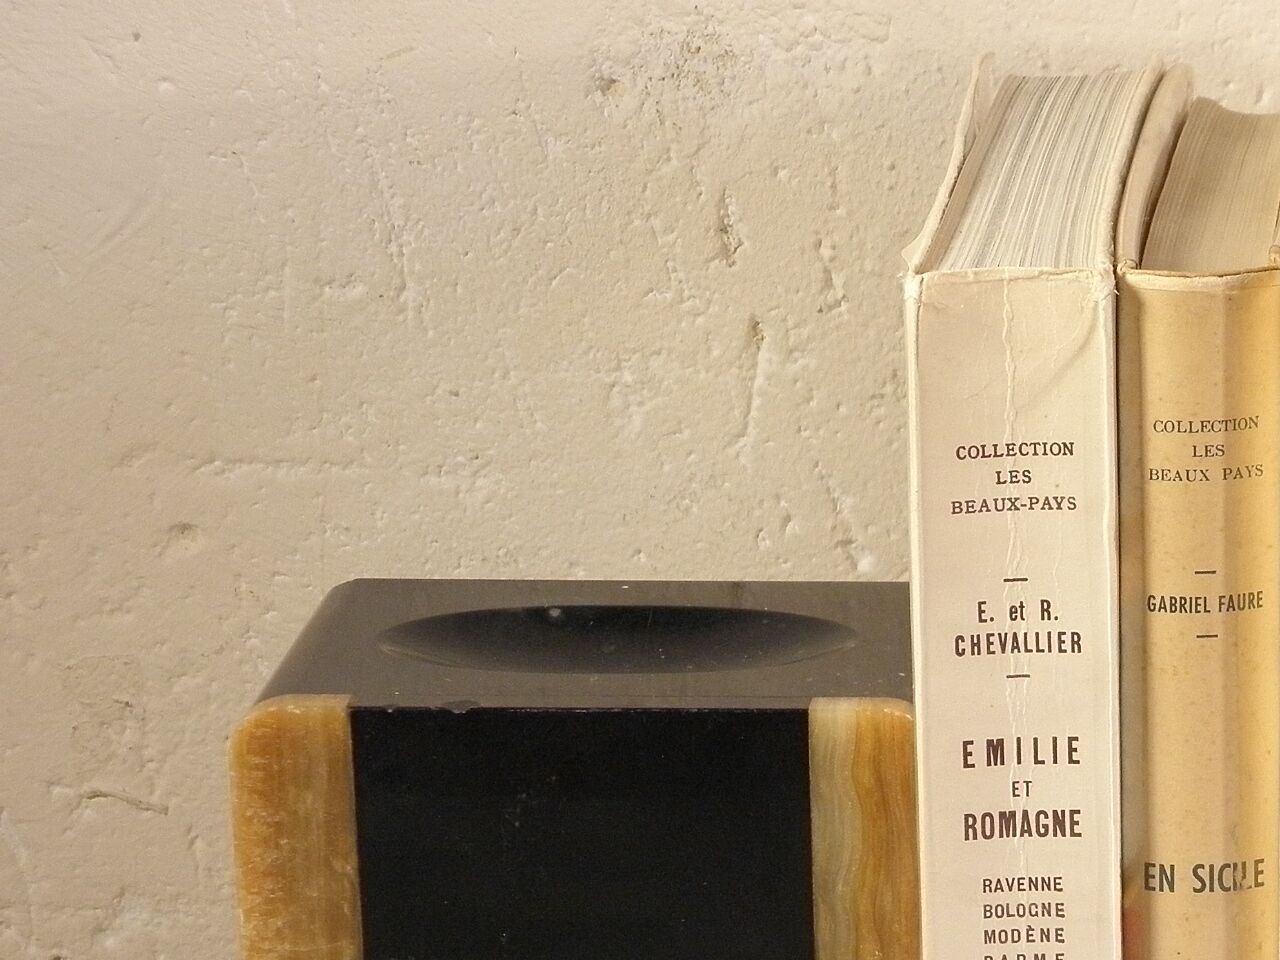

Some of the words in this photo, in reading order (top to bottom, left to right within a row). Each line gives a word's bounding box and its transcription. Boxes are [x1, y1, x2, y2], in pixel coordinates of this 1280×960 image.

[1153, 415, 1259, 435] COLLECTION
[956, 442, 1074, 461] COLLECTION
[1192, 442, 1225, 458] LES
[995, 469, 1032, 485] LES
[1149, 468, 1210, 482] BEAUX
[1222, 464, 1264, 481] PAYS
[951, 496, 1077, 515] BEAUX-PAYS
[978, 601, 994, 623] E.
[1009, 601, 1025, 621] et
[1040, 599, 1058, 621] R.
[1147, 595, 1211, 614] GABRIEL
[1218, 591, 1263, 613] FAURE
[955, 631, 1081, 657] CHEVALLIER
[963, 736, 1080, 768] EMILIE
[1012, 780, 1032, 798] ET
[964, 809, 1082, 841] ROMAGNE
[983, 876, 1063, 893] RAVENNE
[1144, 863, 1175, 893] EN
[983, 902, 1065, 919] BOLOGNE
[984, 925, 1065, 944] MODÈNE
